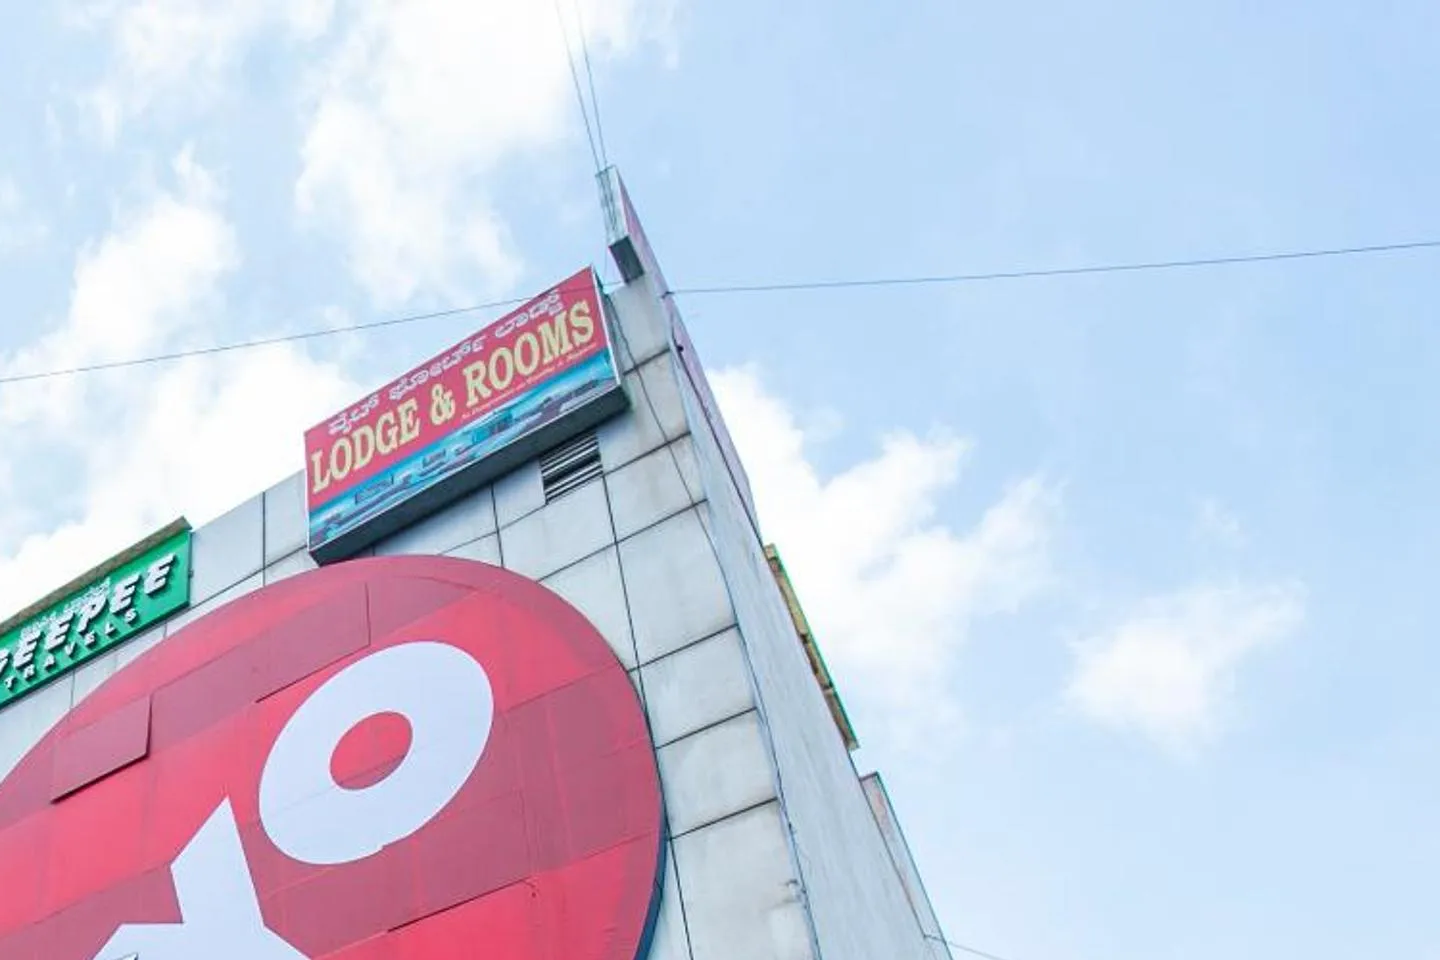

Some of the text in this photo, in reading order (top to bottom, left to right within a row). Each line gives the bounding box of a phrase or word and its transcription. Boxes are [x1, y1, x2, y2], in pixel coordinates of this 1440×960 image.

[311, 397, 421, 494] LODGE
[430, 384, 456, 425] &
[463, 300, 595, 408] ROOMS
[4, 607, 138, 690] TRAVELS
